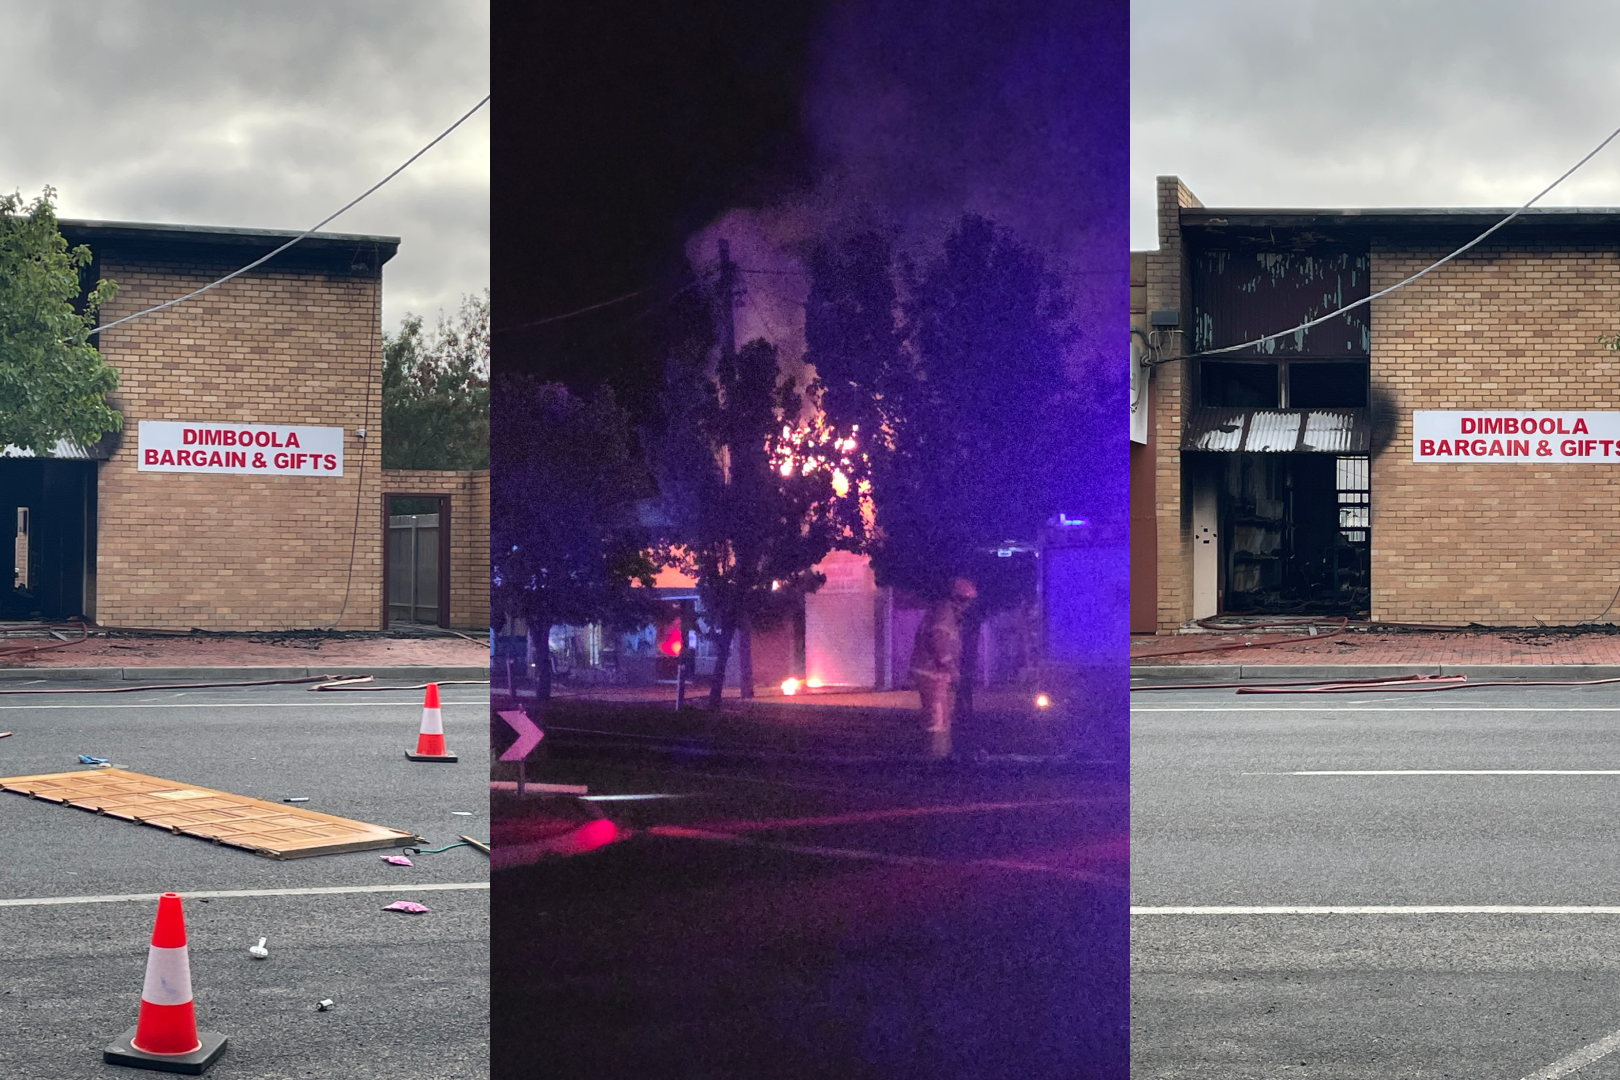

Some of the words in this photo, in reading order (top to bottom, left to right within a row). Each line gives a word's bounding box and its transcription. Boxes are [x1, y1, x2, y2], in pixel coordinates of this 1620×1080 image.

[1461, 417, 1589, 434] DIMBOOLA
[183, 429, 300, 448] DIMBOOLA
[1420, 439, 1529, 456] BARGAIN
[1536, 440, 1553, 456] &
[144, 449, 246, 468] BARGAIN
[252, 452, 267, 468] &
[274, 453, 337, 470] GIFTS
